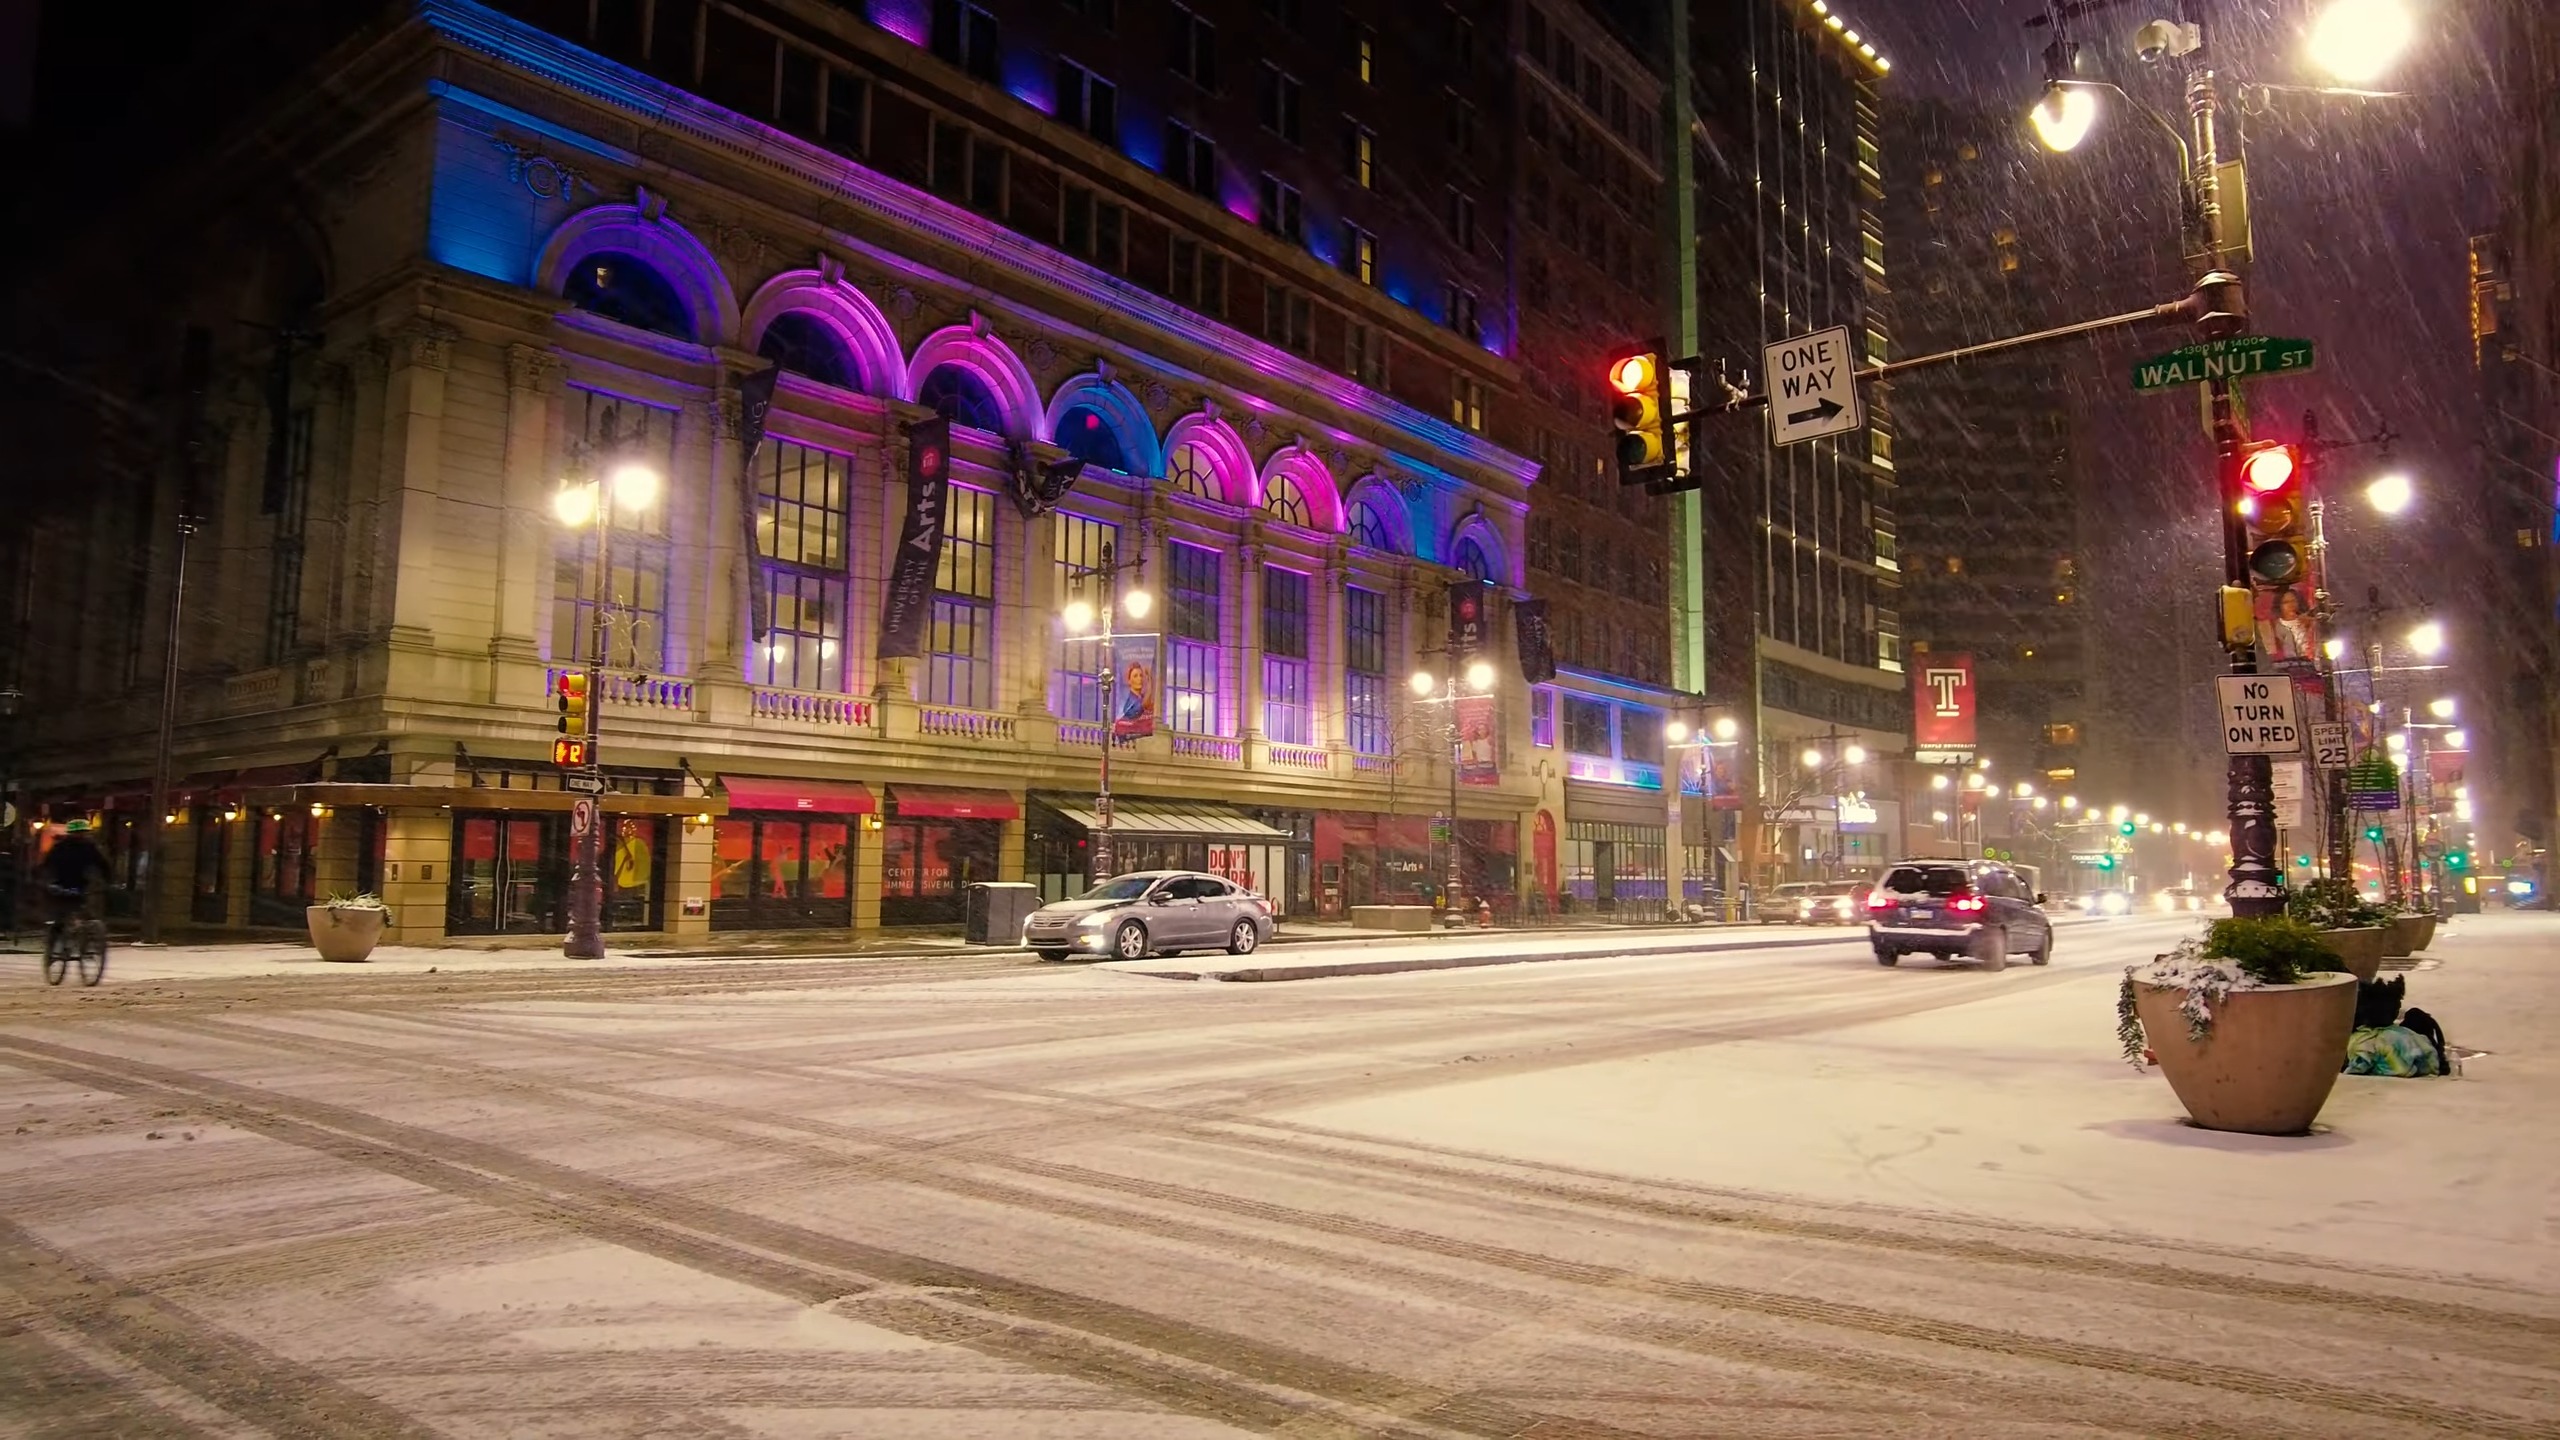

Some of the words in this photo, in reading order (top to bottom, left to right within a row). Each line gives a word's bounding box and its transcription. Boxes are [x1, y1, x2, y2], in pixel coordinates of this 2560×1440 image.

[2184, 344, 2210, 355] 1300
[2213, 341, 2226, 352] W
[2231, 337, 2259, 348] 1400
[1781, 340, 1833, 372] ONE
[2140, 349, 2267, 387] WALNUT
[2281, 350, 2307, 367] ST
[1782, 366, 1836, 399] WAY
[909, 481, 936, 552] Arts
[889, 559, 915, 633] UNIVERSITY
[2243, 683, 2269, 699] NO
[2233, 705, 2285, 721] TURN
[2229, 727, 2253, 743] ON
[2259, 727, 2296, 742] RED
[2313, 727, 2349, 736] SPEED
[2318, 737, 2345, 746] LIMIT
[2319, 748, 2347, 764] 25
[1210, 849, 1247, 869] DON'T
[931, 867, 949, 877] FOR
